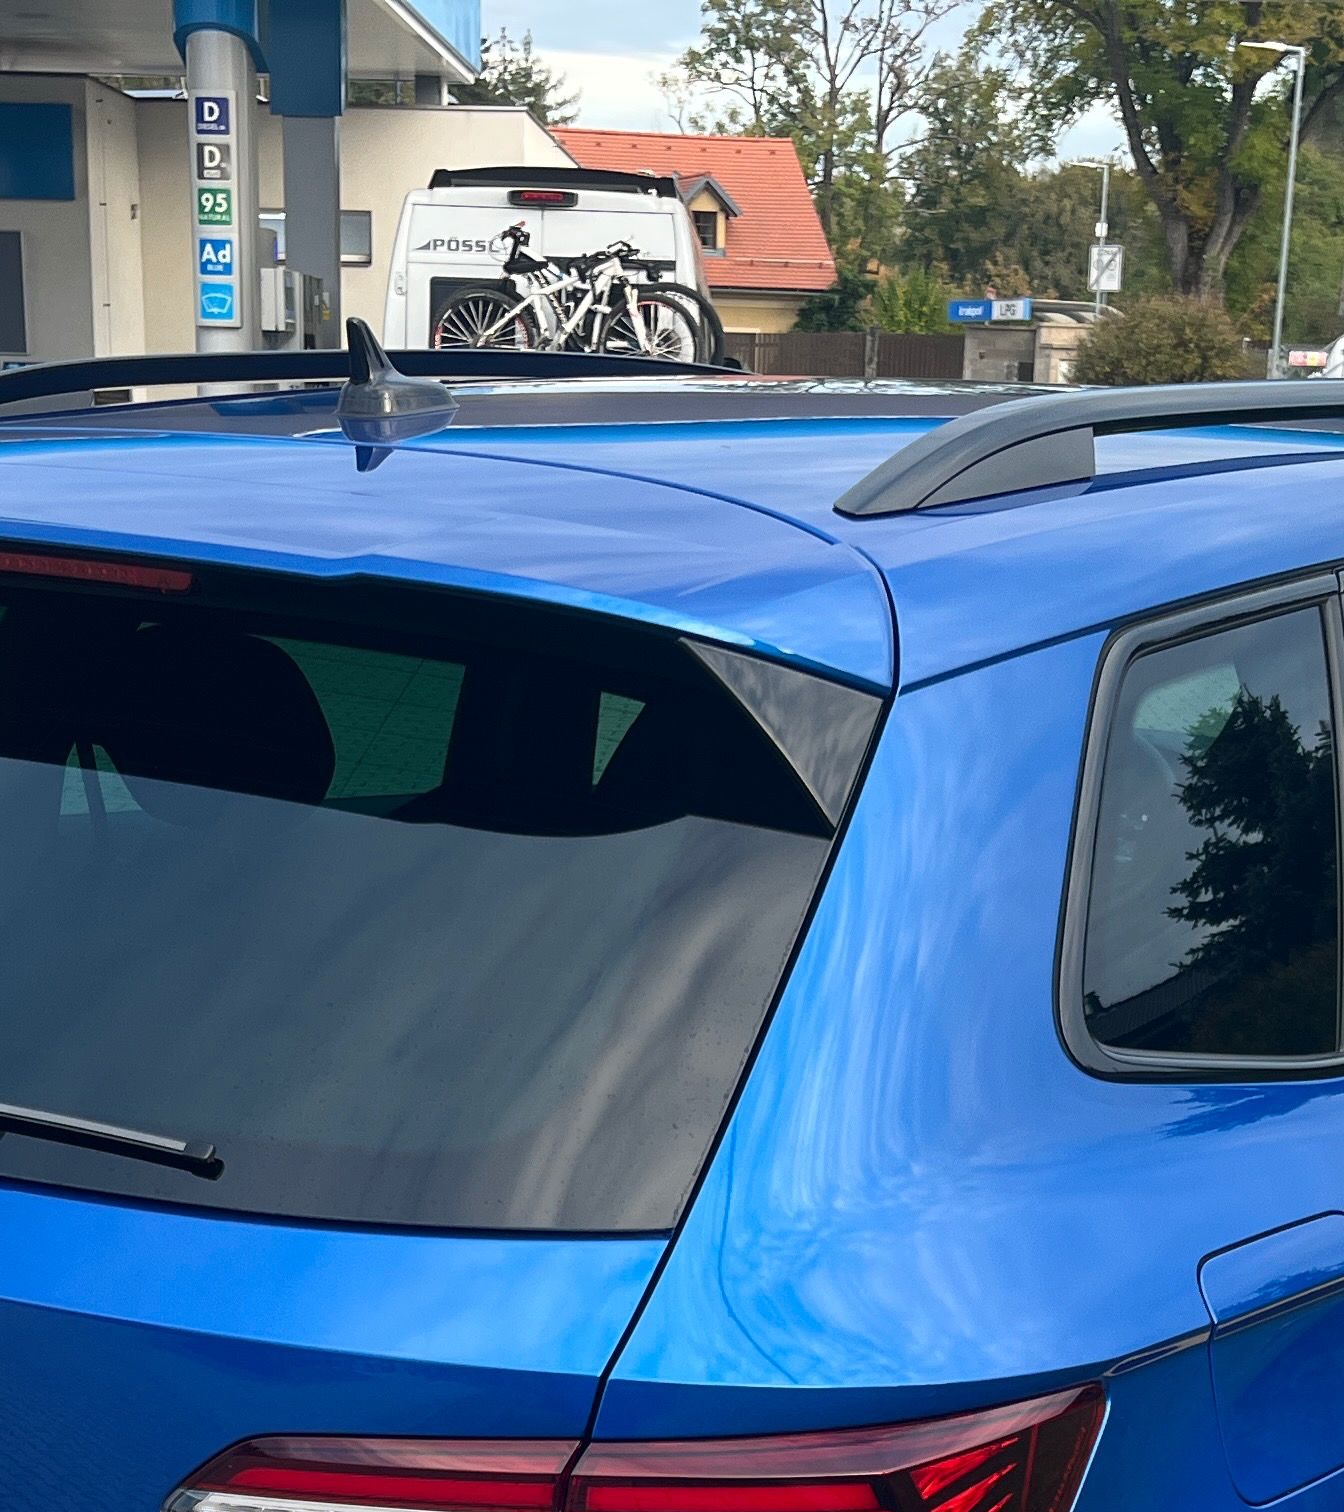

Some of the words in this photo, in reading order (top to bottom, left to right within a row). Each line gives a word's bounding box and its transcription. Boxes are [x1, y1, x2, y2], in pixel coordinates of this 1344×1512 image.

[203, 101, 220, 122] D
[203, 145, 221, 168] D
[201, 193, 228, 212] 95
[201, 243, 231, 263] Ad
[1000, 304, 1017, 316] LPG
